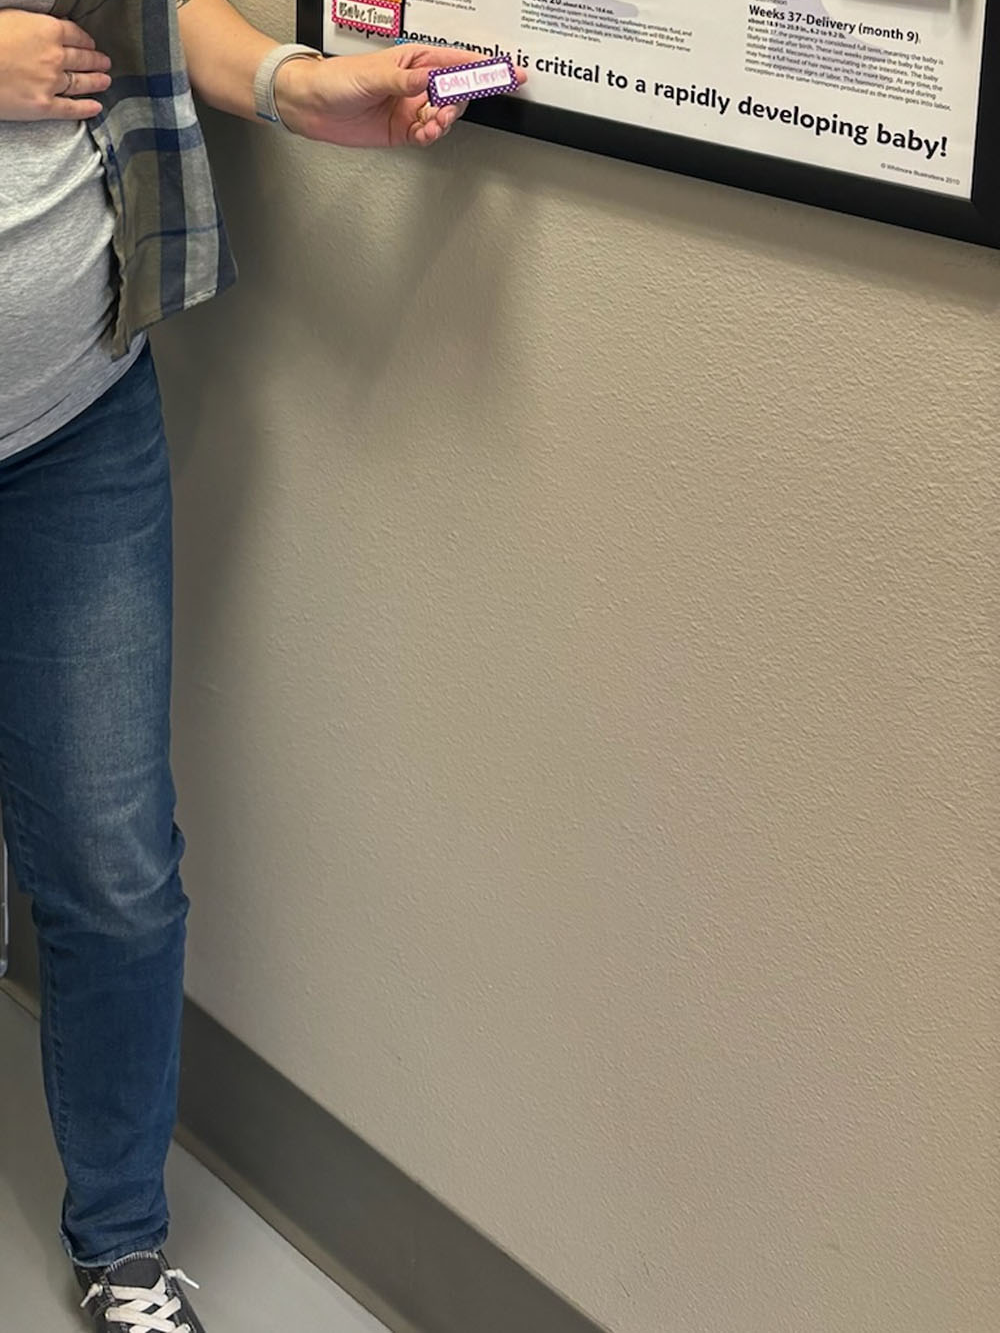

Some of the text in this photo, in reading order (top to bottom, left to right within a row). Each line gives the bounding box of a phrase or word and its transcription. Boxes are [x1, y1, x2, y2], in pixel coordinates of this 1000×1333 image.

[749, 4, 785, 21] Weeks
[787, 10, 856, 34] 37-Delivery
[858, 22, 903, 40] (month
[517, 49, 530, 68] is
[536, 57, 600, 83] critical
[606, 70, 628, 89] to
[635, 78, 646, 94] a
[654, 80, 730, 115] rapidly
[738, 96, 869, 146] developing
[877, 122, 948, 159] baby!
